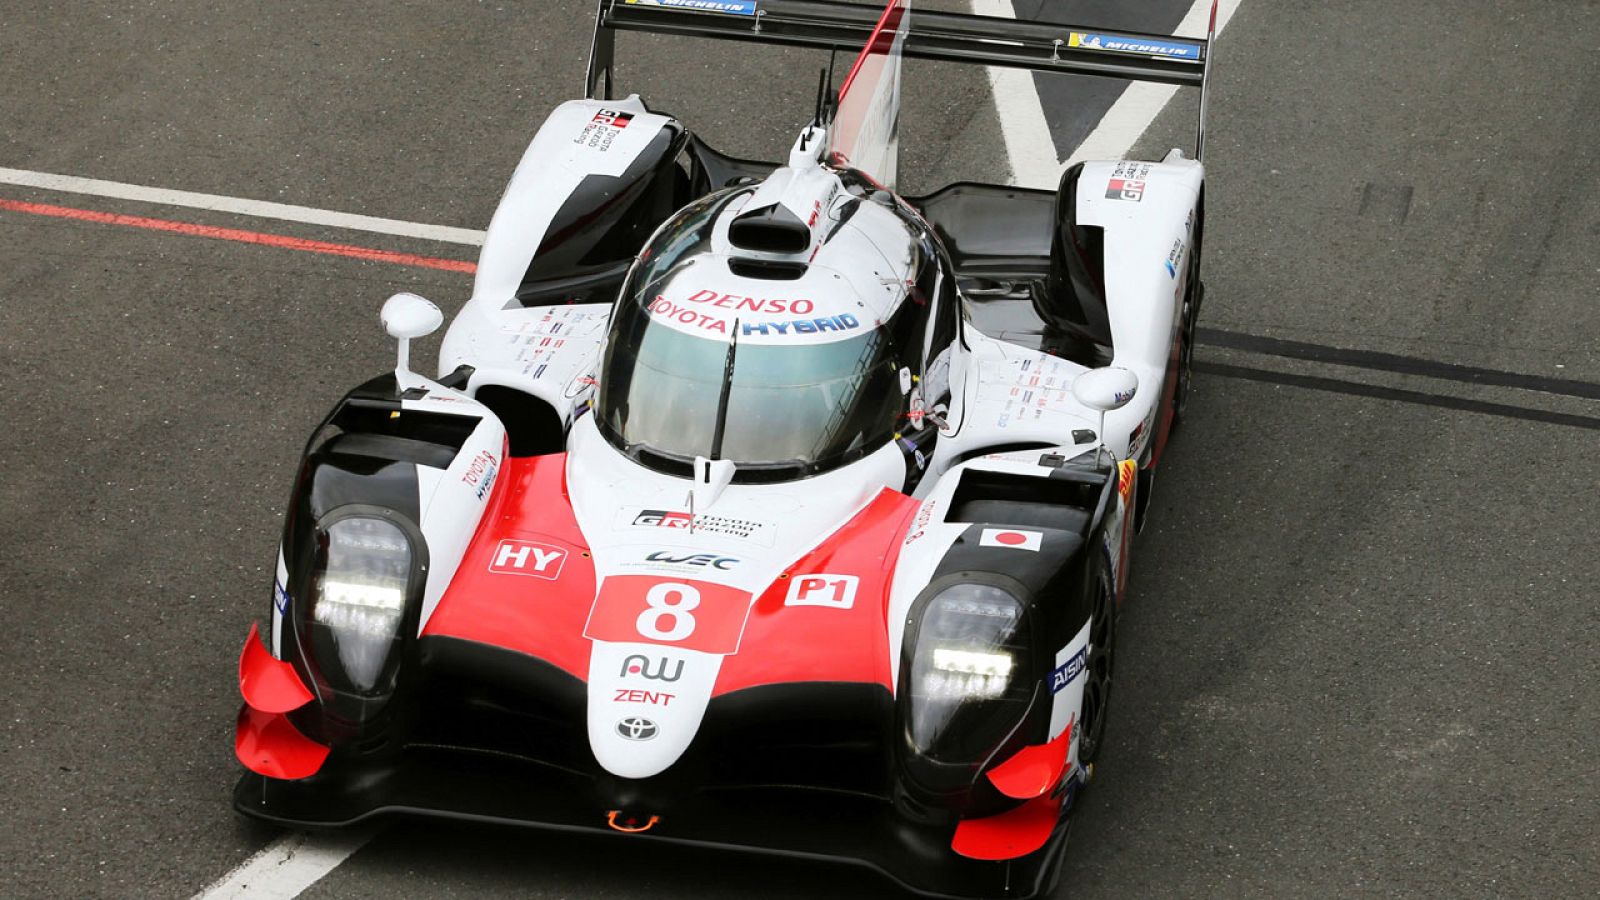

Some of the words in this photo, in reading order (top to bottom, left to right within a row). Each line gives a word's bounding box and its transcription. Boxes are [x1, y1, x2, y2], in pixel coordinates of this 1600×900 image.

[662, 0, 745, 11] MICHELIN
[1106, 41, 1188, 55] MICHELIN
[688, 289, 814, 315] DENSO
[647, 294, 726, 334] TOYOTA
[742, 313, 860, 336] HYBRID
[696, 520, 754, 531] GAZOO
[702, 515, 763, 528] TOYOTA
[495, 544, 563, 571] HY
[645, 551, 740, 570] WEC
[797, 578, 849, 602] P1
[635, 582, 700, 641] 8
[1053, 649, 1087, 690] AISIN
[613, 689, 676, 706] ZENT
